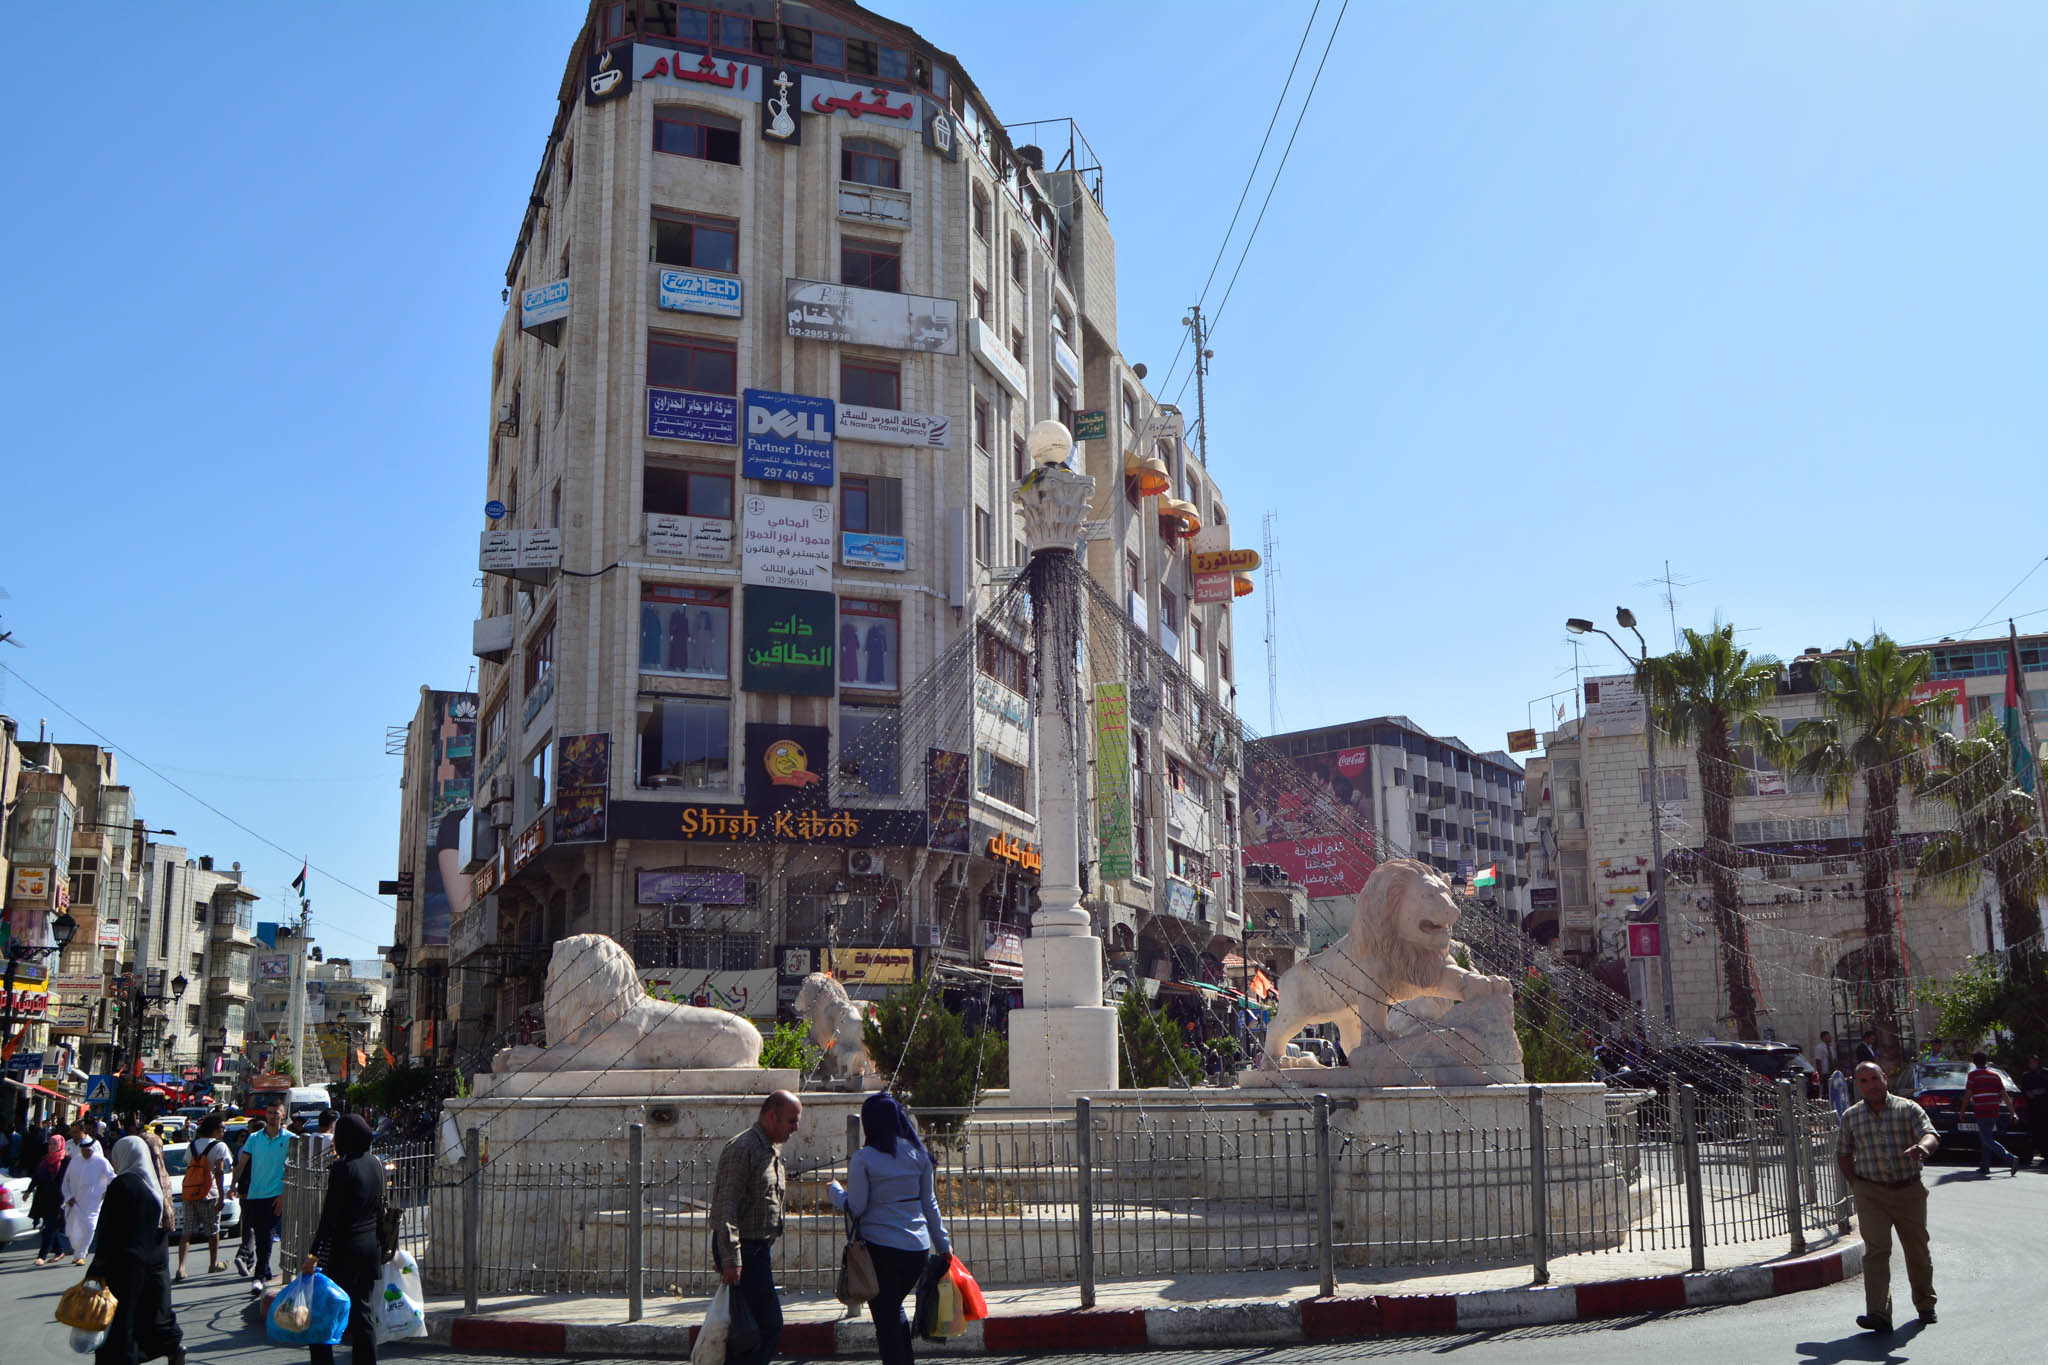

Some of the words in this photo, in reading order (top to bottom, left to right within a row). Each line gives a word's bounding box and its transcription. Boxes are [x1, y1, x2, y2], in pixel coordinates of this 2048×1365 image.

[642, 50, 749, 91] الشام
[812, 87, 914, 120] مقهى
[666, 273, 694, 288] Fun
[700, 277, 736, 298] Tech
[714, 401, 733, 418] شركة
[841, 408, 867, 421] للسفر
[748, 405, 832, 442] DELL
[871, 415, 899, 426] النورس
[901, 416, 927, 430] وكالة
[850, 421, 876, 431] Nawras
[878, 423, 899, 433] Travel
[900, 427, 927, 438] Agency
[747, 438, 791, 454] Partner
[794, 444, 831, 459] Direct
[763, 467, 783, 478] 297
[785, 470, 799, 480] 40
[801, 471, 815, 481] 45
[768, 516, 809, 529] المحامي
[744, 527, 777, 540] الحموز
[799, 535, 830, 546] محمود
[745, 544, 776, 555] القانون
[776, 547, 790, 558] في
[792, 550, 830, 561] ماجستير
[760, 563, 787, 574] الثالث
[787, 566, 815, 577] الطابق
[768, 612, 814, 636] ذات
[747, 639, 832, 668] النطاقين
[1338, 752, 1366, 767] Coca-Cola
[681, 807, 760, 841] Shish
[773, 809, 861, 841] Kabob
[989, 832, 1020, 864] كباب
